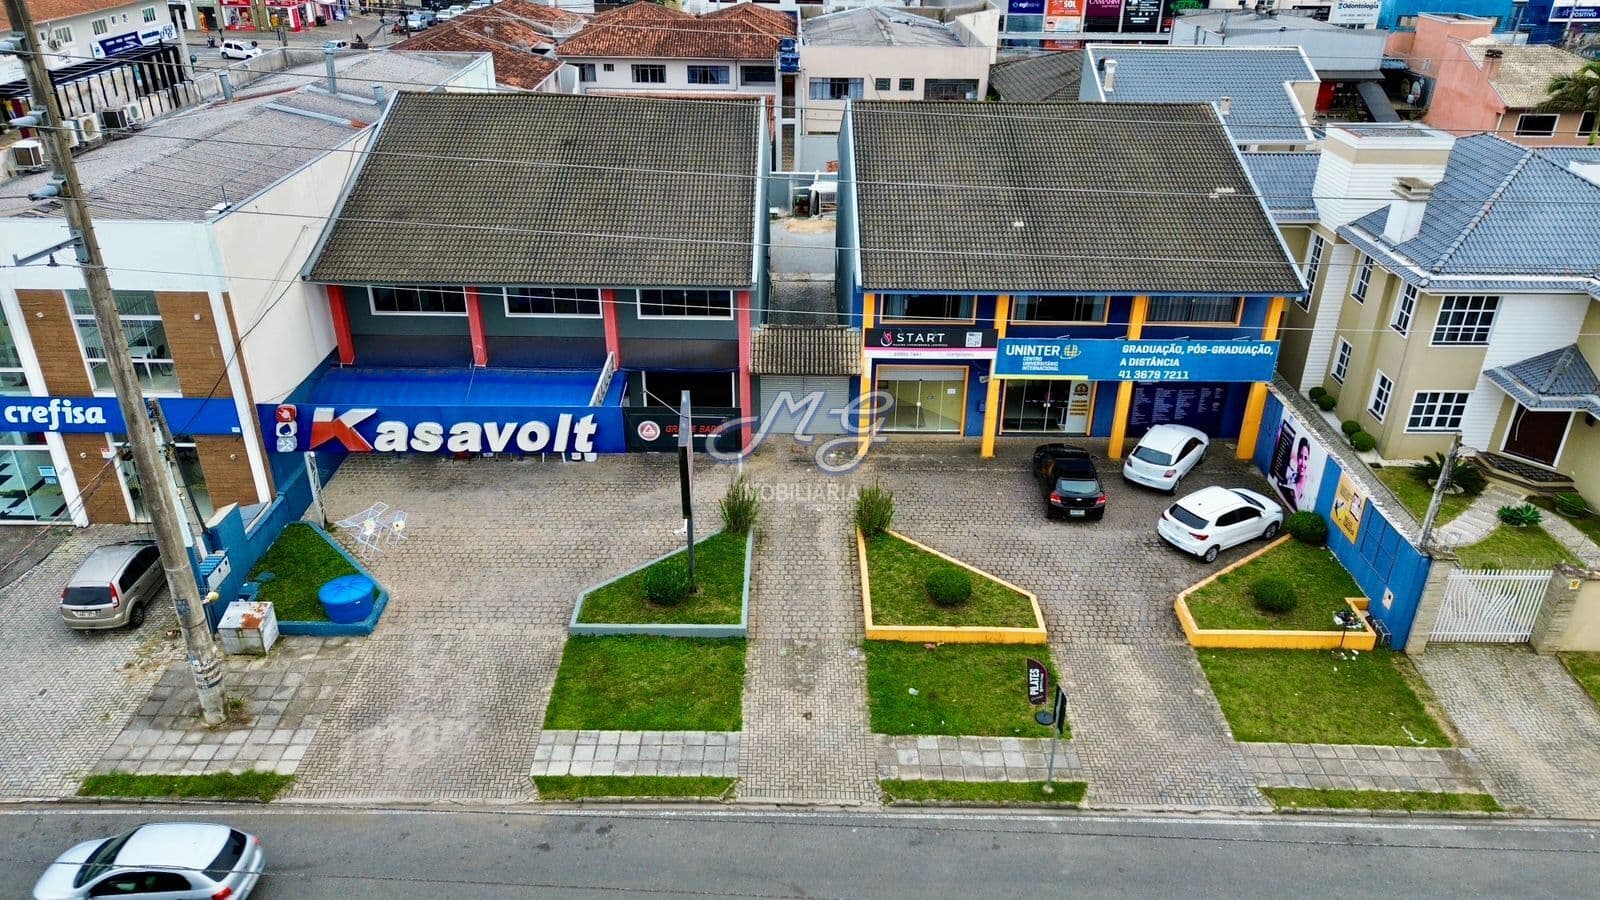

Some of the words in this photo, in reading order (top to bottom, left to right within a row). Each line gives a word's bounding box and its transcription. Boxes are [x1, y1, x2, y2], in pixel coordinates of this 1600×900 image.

[896, 332, 946, 343] START
[1005, 344, 1060, 356] UNINTER
[1122, 343, 1184, 355] GRADUAÇÃO,
[1187, 343, 1274, 356] PÓS-GRADUAÇÃO,
[1120, 358, 1127, 367] A
[1128, 356, 1180, 367] DISTÂNCIA
[1118, 370, 1132, 379] 41
[1133, 370, 1161, 380] 3679
[1163, 370, 1189, 380] 7211
[4, 399, 107, 430] crefisa
[309, 407, 598, 453] Kasavolt
[665, 425, 697, 433] GRAE
